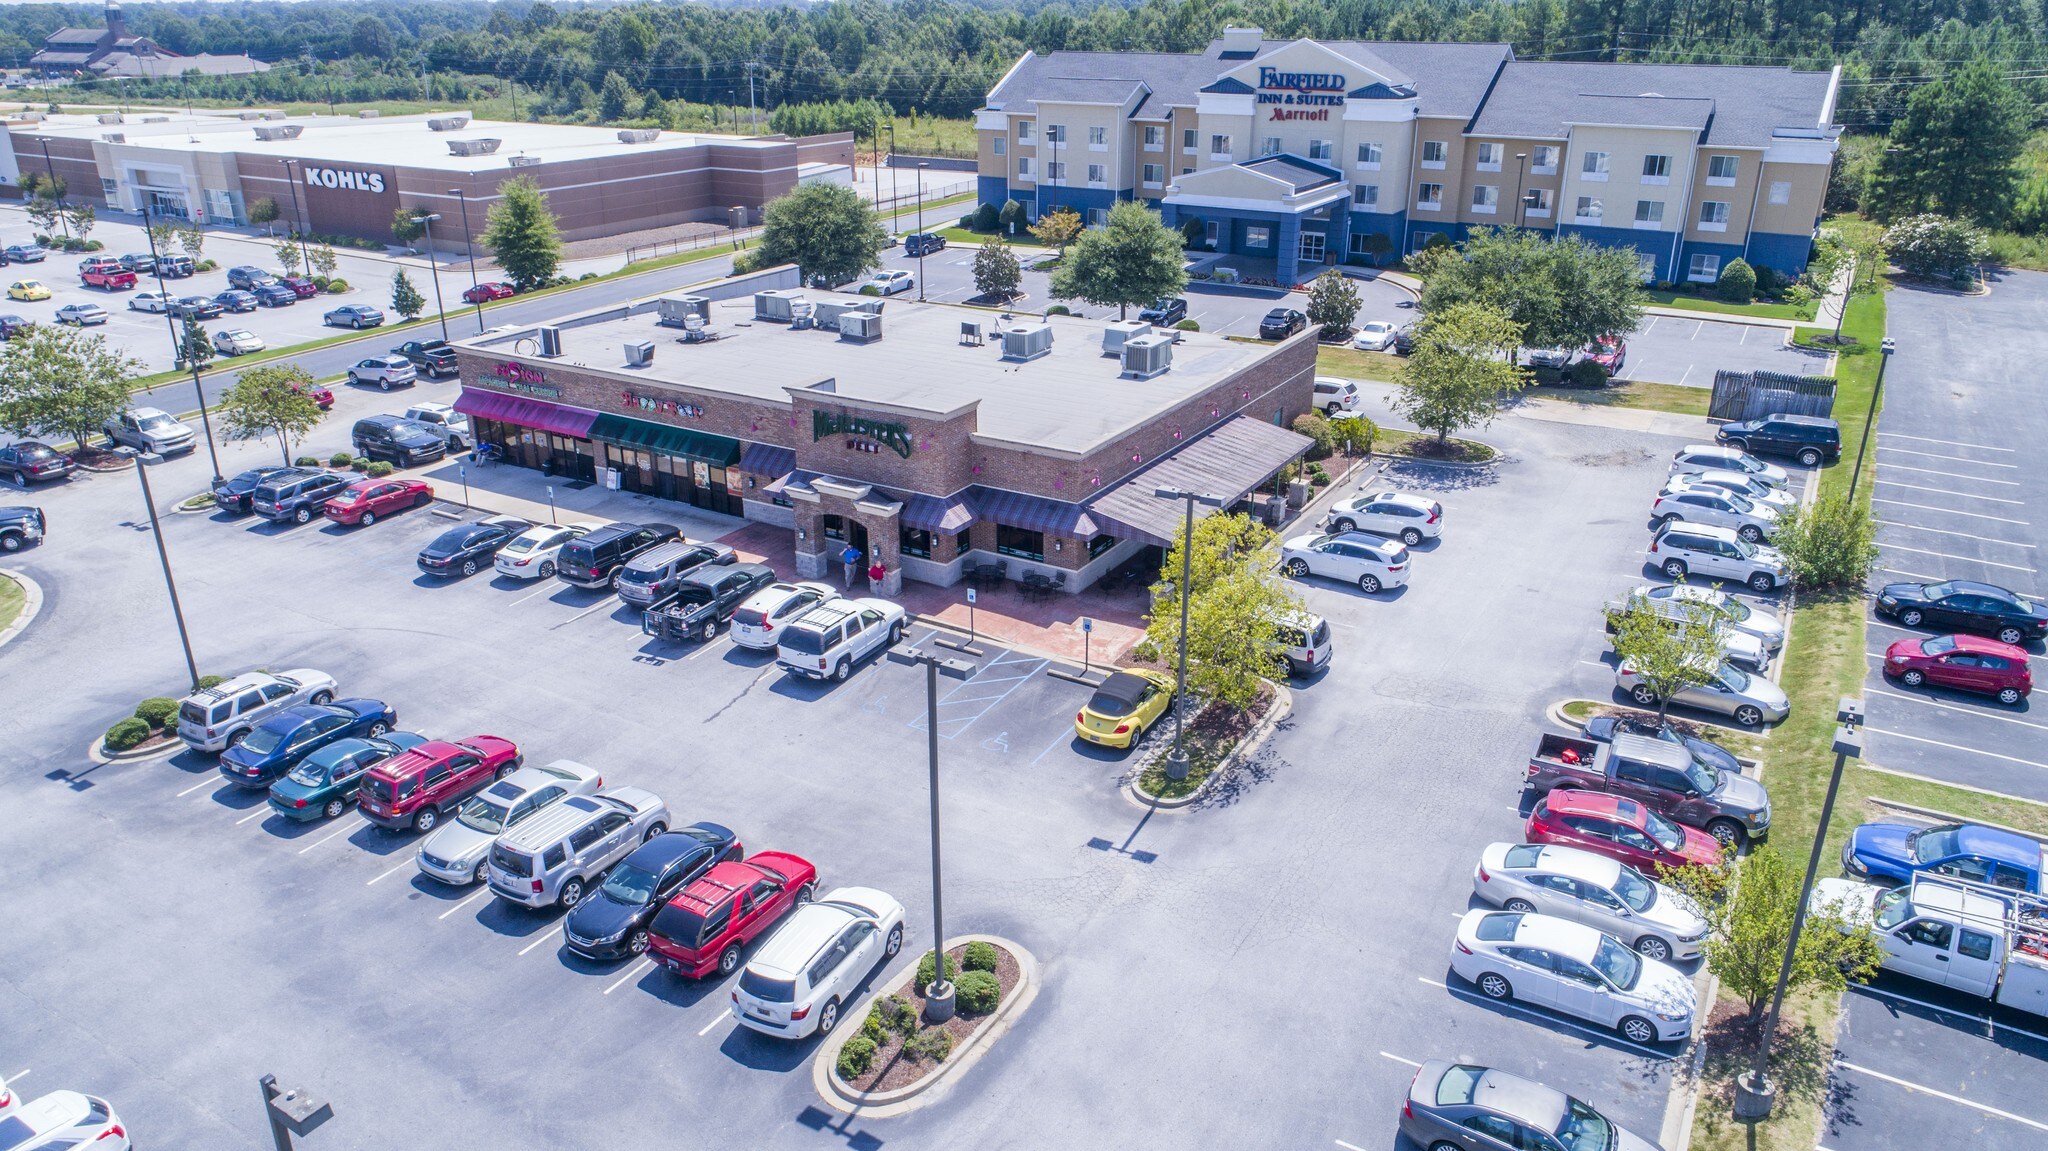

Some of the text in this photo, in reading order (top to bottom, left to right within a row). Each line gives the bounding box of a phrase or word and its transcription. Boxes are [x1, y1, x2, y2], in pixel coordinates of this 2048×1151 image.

[1257, 66, 1345, 93] FAIRFIELD
[1257, 94, 1344, 106] INN & SUITES
[1269, 107, 1329, 121] Marriott
[305, 168, 384, 193] KOHL'S
[846, 440, 879, 454] DELI
